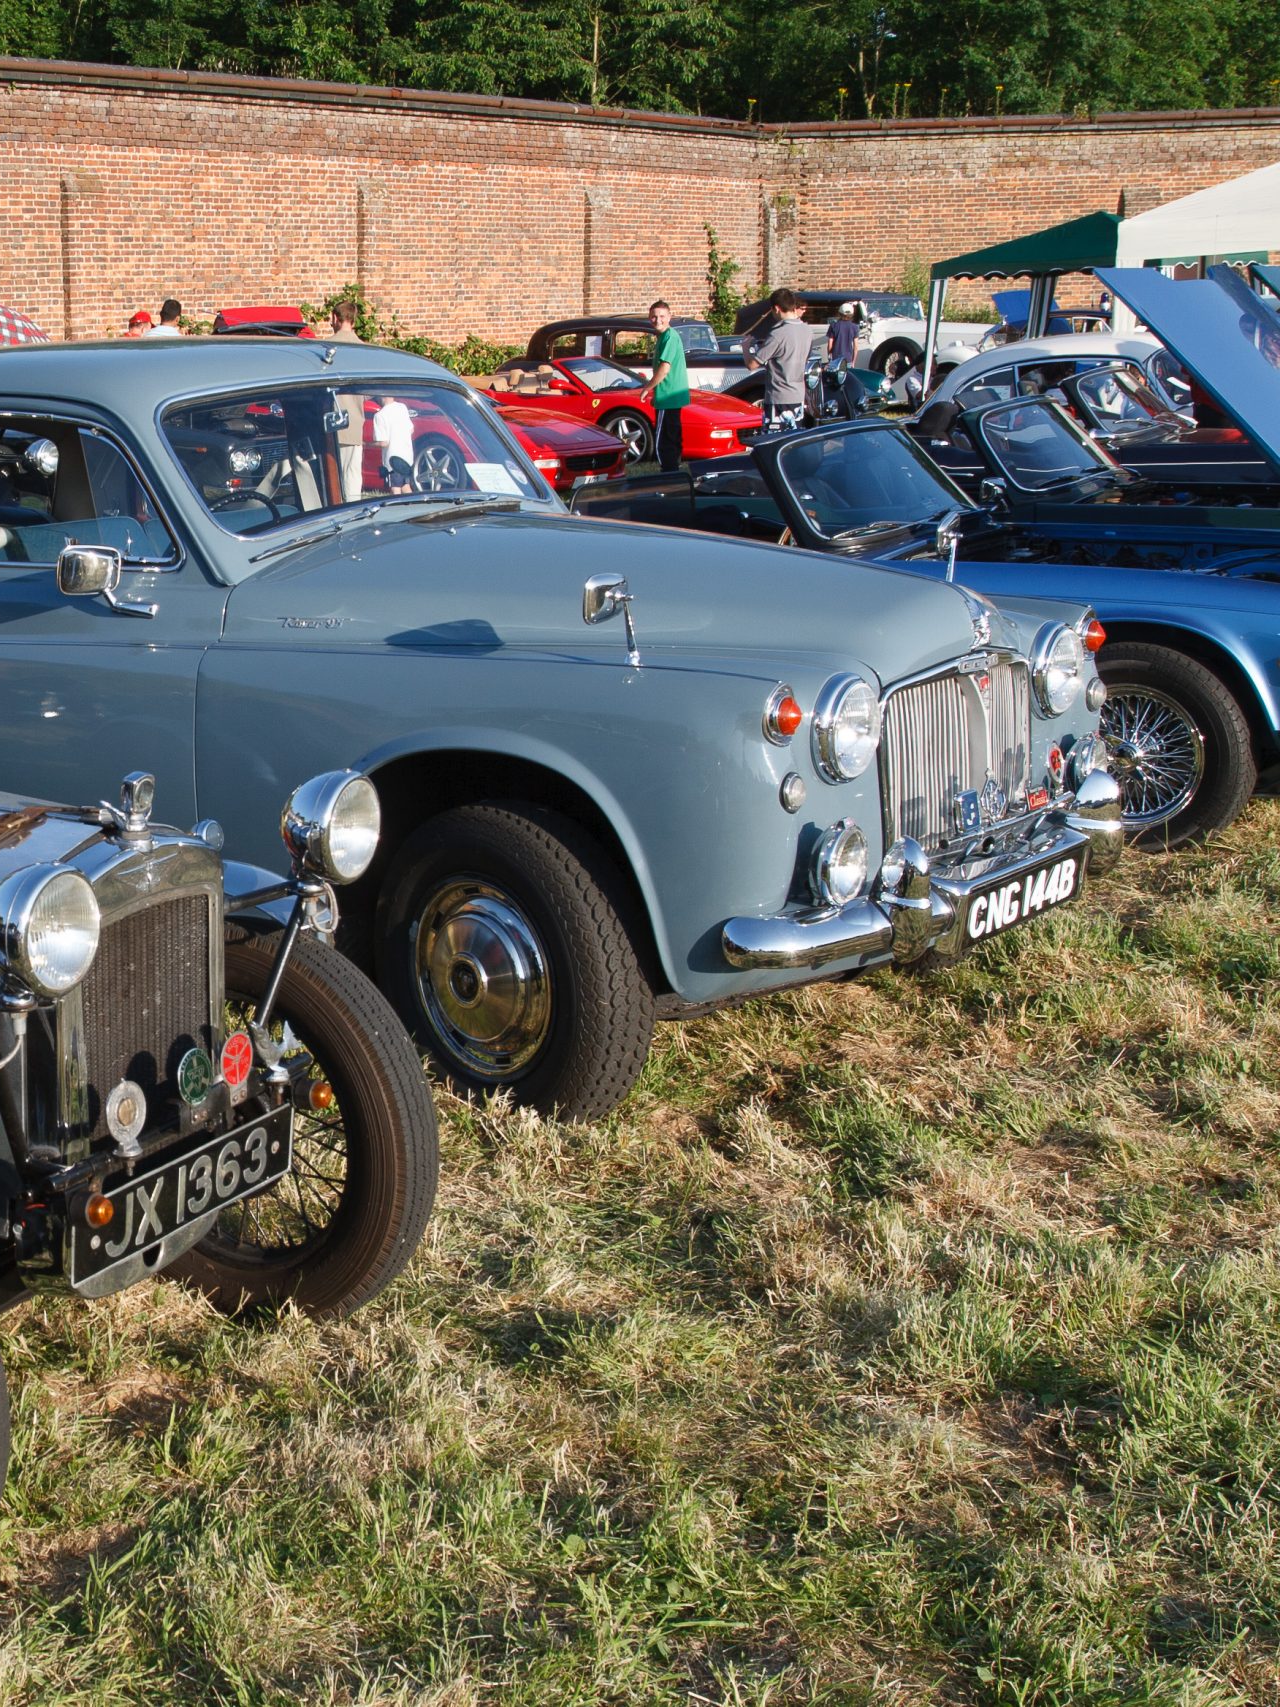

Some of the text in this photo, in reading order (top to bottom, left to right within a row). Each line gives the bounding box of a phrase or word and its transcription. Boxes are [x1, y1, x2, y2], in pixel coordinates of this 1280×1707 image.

[968, 858, 1076, 939] CNG 144B
[104, 1126, 268, 1258] JX 1363
